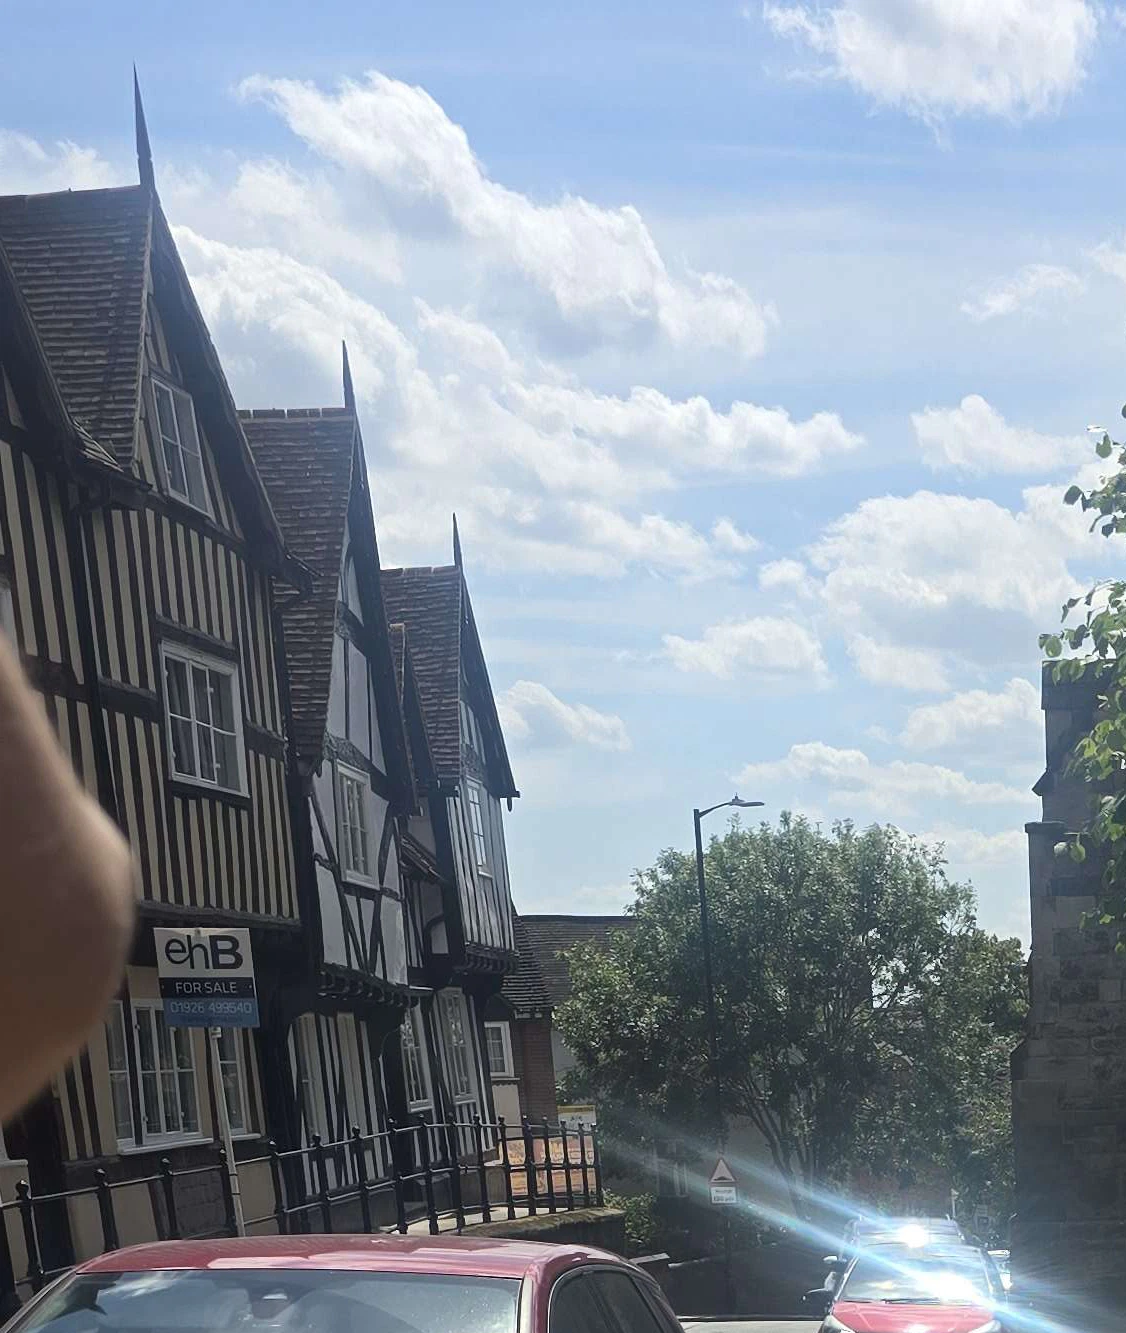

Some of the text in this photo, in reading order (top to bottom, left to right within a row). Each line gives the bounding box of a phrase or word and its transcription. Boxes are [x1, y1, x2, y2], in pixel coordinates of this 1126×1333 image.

[165, 934, 244, 970] ehB
[175, 981, 238, 994] FOR SALE
[170, 1002, 205, 1014] 01926
